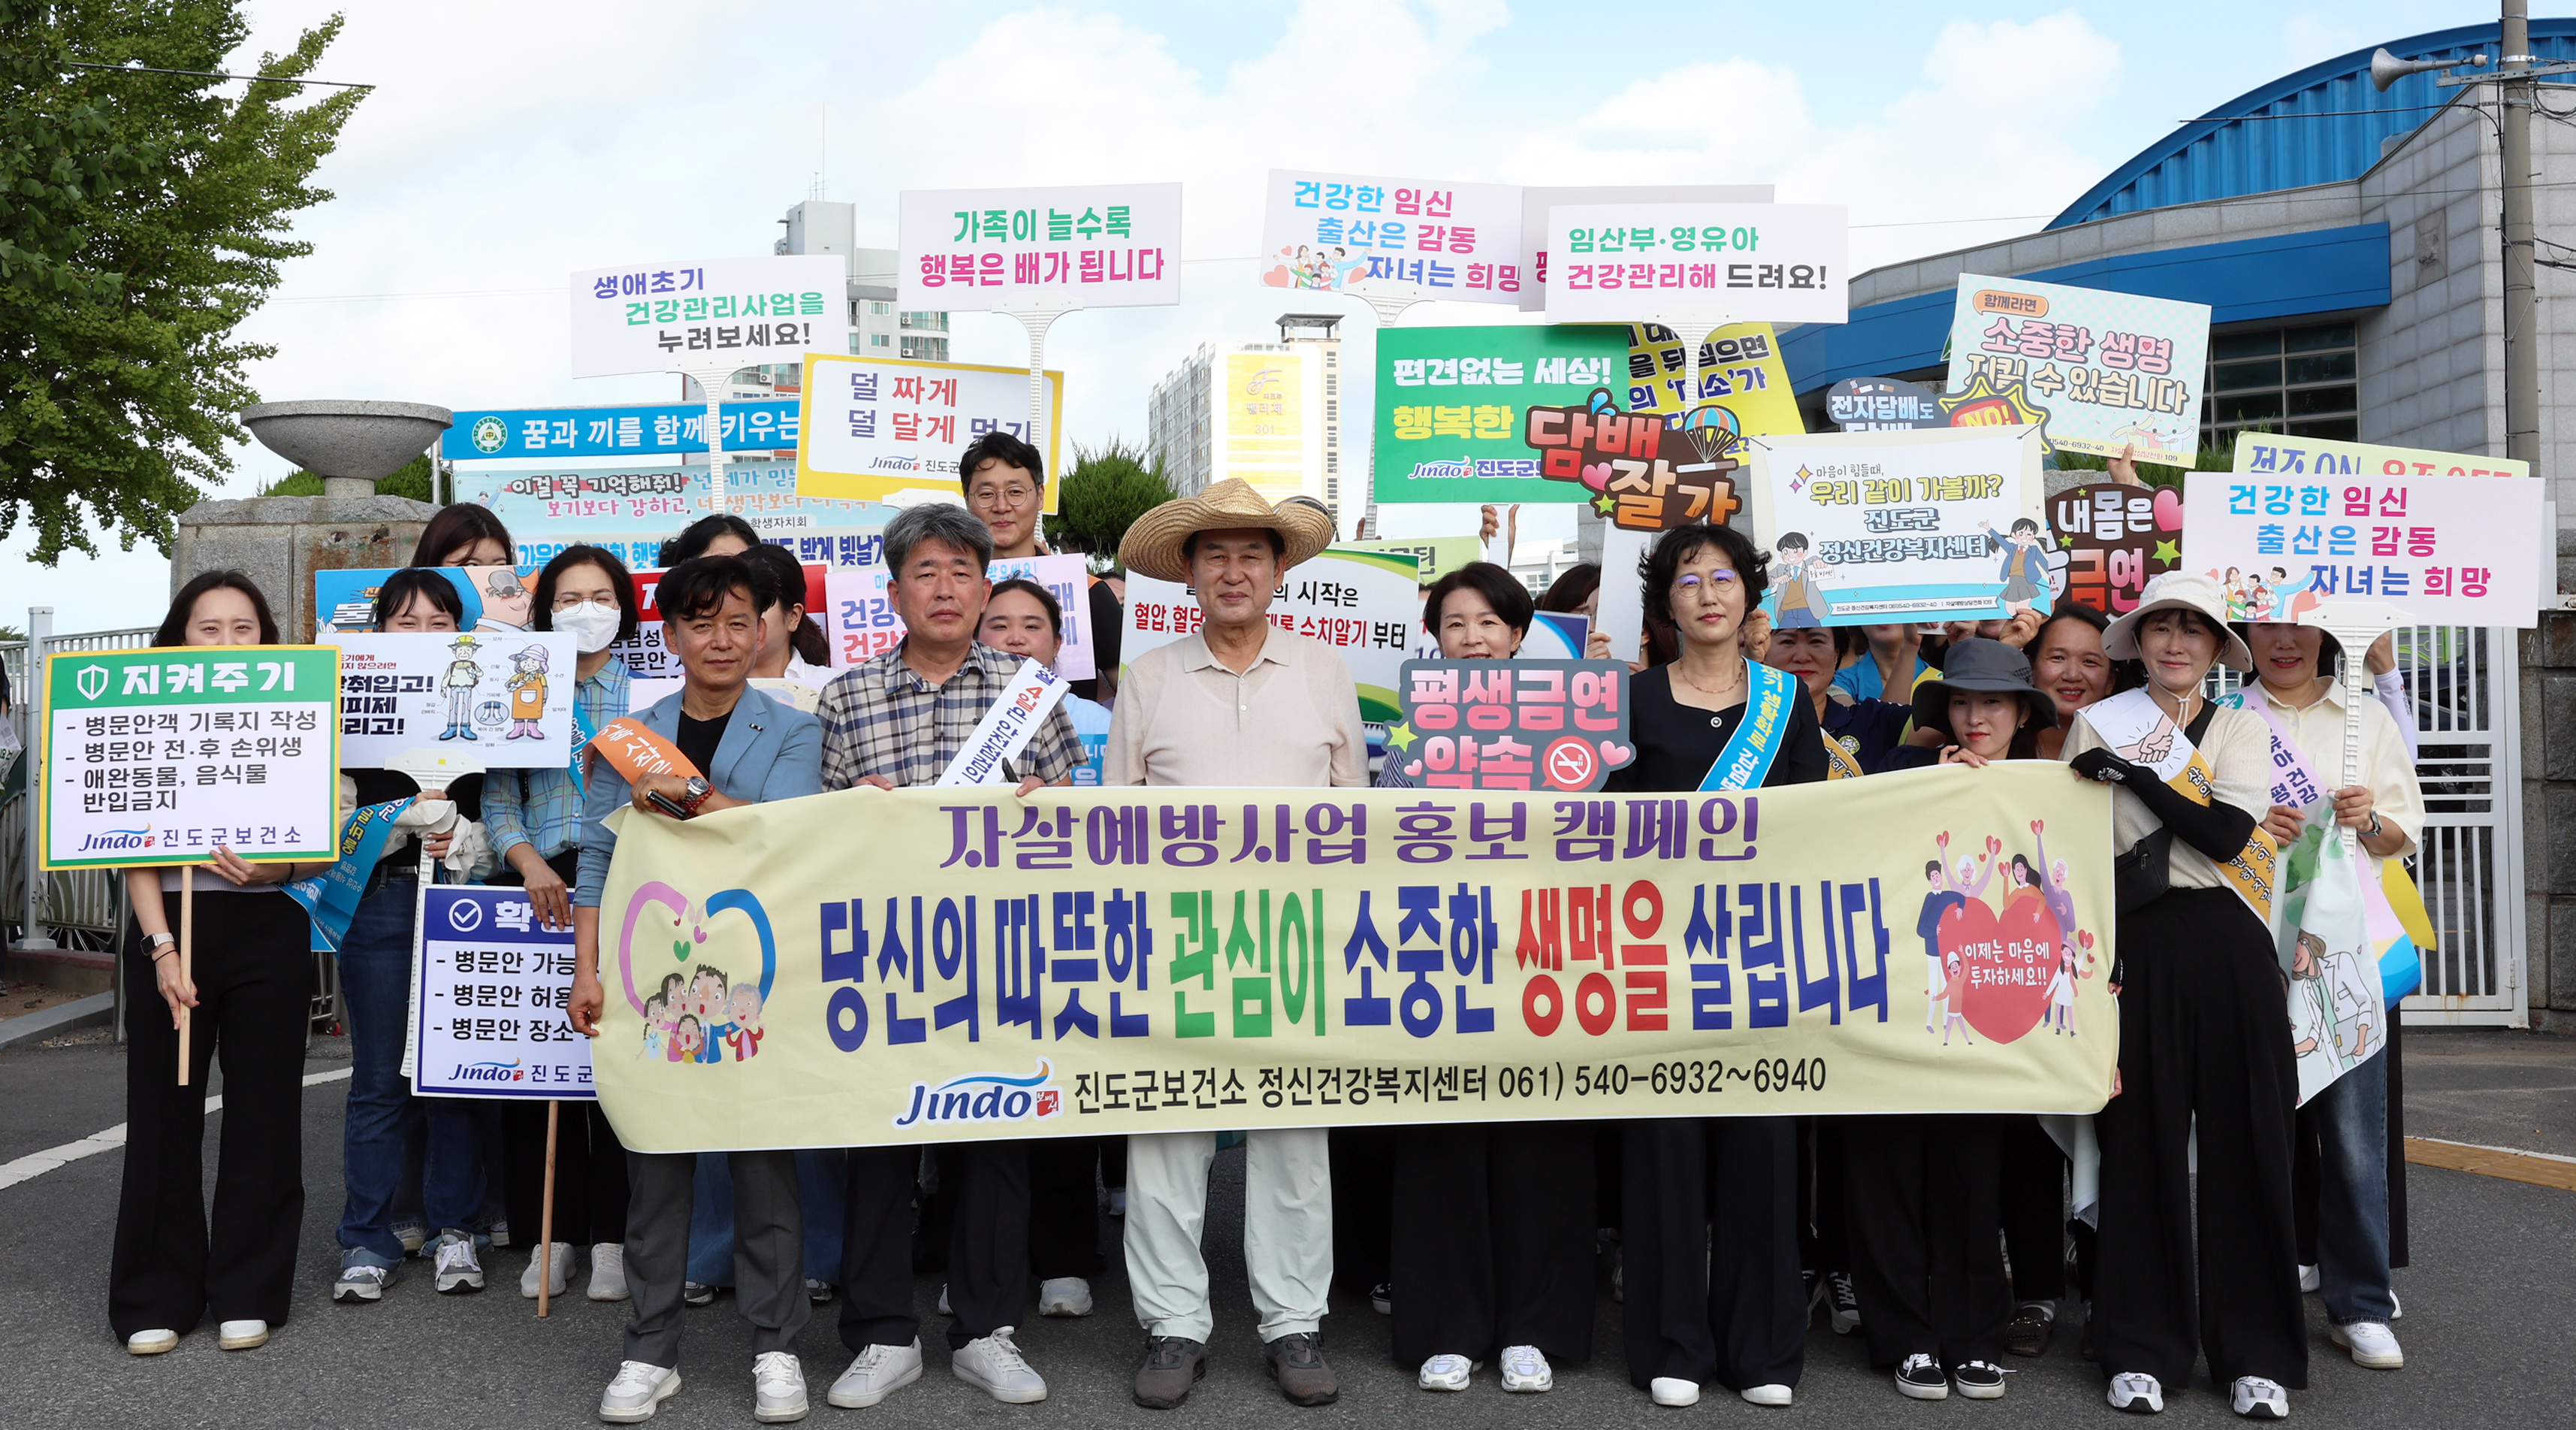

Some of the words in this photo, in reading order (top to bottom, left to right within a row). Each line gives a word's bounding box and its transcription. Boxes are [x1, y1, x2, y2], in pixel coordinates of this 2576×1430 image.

[1294, 180, 1385, 213] 건강한
[1394, 188, 1453, 218] 임신
[954, 209, 1037, 243] 가족이
[1047, 205, 1131, 241] 늘수록
[1316, 216, 1406, 249] 출산은
[1418, 224, 1476, 255] 감동
[1569, 226, 1759, 253] 임산부·영유아
[920, 252, 1004, 287] 행복은
[1014, 251, 1070, 285] 배가
[1079, 248, 1164, 283] 됩니다
[1365, 255, 1456, 288] 자녀는
[1465, 262, 1521, 292] 희망
[1567, 263, 1717, 290] 건강관리해
[1726, 263, 1827, 290] 드려요!
[593, 268, 704, 299] 생애초기
[625, 292, 825, 326] 건강관리사업을
[1984, 293, 2037, 313] 함께라면
[658, 322, 811, 353] 누려보세요!
[1981, 317, 2095, 362] 소중한
[2100, 331, 2172, 374] 생명
[1394, 357, 1524, 387] 편견없는
[1533, 357, 1611, 385] 세상!
[850, 373, 878, 401] 덜
[892, 376, 957, 407] 짜게
[2032, 364, 2063, 397] 수
[2069, 370, 2189, 416] 있습니다
[1394, 405, 1514, 440] 행복한
[1832, 395, 1934, 420] 전자담배도
[1964, 404, 2013, 428] NO!
[522, 418, 578, 449] 꿈과
[587, 415, 643, 448] 끼를
[654, 413, 708, 446] 함께
[721, 411, 799, 443] 키우는
[848, 410, 877, 439] 덜
[892, 413, 956, 444] 달게
[1255, 425, 1275, 434] 301
[1530, 410, 1662, 479] 담배
[2111, 446, 2164, 460] 자살방상담전화
[2164, 454, 2179, 463] 109
[868, 456, 912, 471] Jindo
[1409, 463, 1463, 479] Jindo
[1816, 464, 1847, 479] 마음이
[512, 476, 551, 498] 이걸
[560, 475, 578, 497] 꼭
[587, 473, 681, 494] 기억해줘!
[1810, 480, 1858, 506] 우리
[1863, 478, 1912, 503] 같이
[1916, 474, 2004, 501] 가볼까?
[547, 500, 620, 517] 보기보다
[627, 497, 692, 517] 강하고,
[724, 494, 796, 513] 생각보다
[2057, 491, 2153, 541] 내몸은
[2228, 485, 2331, 516] 건강한
[2342, 486, 2408, 518] 임신
[1863, 507, 1940, 534] 진도군
[1819, 534, 1991, 565] 정신건강복지센터
[2256, 524, 2357, 556] 출산은
[2371, 526, 2436, 558] 감동
[1297, 581, 1360, 608] 시작은
[2069, 547, 2145, 613] 금연
[2309, 565, 2410, 597] 자녀는
[2423, 567, 2491, 598] 희망
[1300, 615, 1367, 648] 수치알기
[1373, 622, 1406, 651] 부터
[121, 661, 295, 695] 지켜주기
[1411, 669, 1619, 732] 평생금연
[86, 713, 179, 737] 병문안객
[189, 711, 259, 732] 기록지
[270, 709, 317, 731] 작성
[85, 741, 155, 763] 병문안
[231, 736, 302, 759] 손위생
[1424, 736, 1534, 791] 약속
[84, 766, 186, 790] 애완동물,
[195, 763, 267, 785] 음식물
[2286, 767, 2319, 805] 건강
[83, 789, 177, 814] 반입금지
[78, 833, 142, 852] Jindo
[162, 826, 301, 848] 진도군보건소
[940, 802, 1368, 870] 자살예방사업
[1393, 800, 1530, 864] 홍보
[1552, 796, 1759, 863] 캠페인
[454, 950, 524, 975] 병문안
[820, 894, 980, 1053] 당신의
[994, 887, 1152, 1042] 따뜻한
[1169, 887, 1327, 1040] 관심이
[1343, 882, 1499, 1038] 소중한
[1514, 878, 1669, 1037] 생명을
[1683, 876, 1890, 1031] 살립니다
[1964, 939, 2004, 963] 이제는
[2008, 938, 2049, 962] 마음에
[1971, 966, 2047, 990] 투자하세요!!
[453, 984, 523, 1008] 병문안
[451, 1017, 521, 1042] 병문안
[448, 1063, 511, 1081] Jindo
[901, 1082, 1032, 1126] Jindo
[1074, 1068, 1248, 1115] 진도군보건소
[1258, 1064, 1487, 1108] 정신건강복지센터
[1498, 1064, 1564, 1104] 061)
